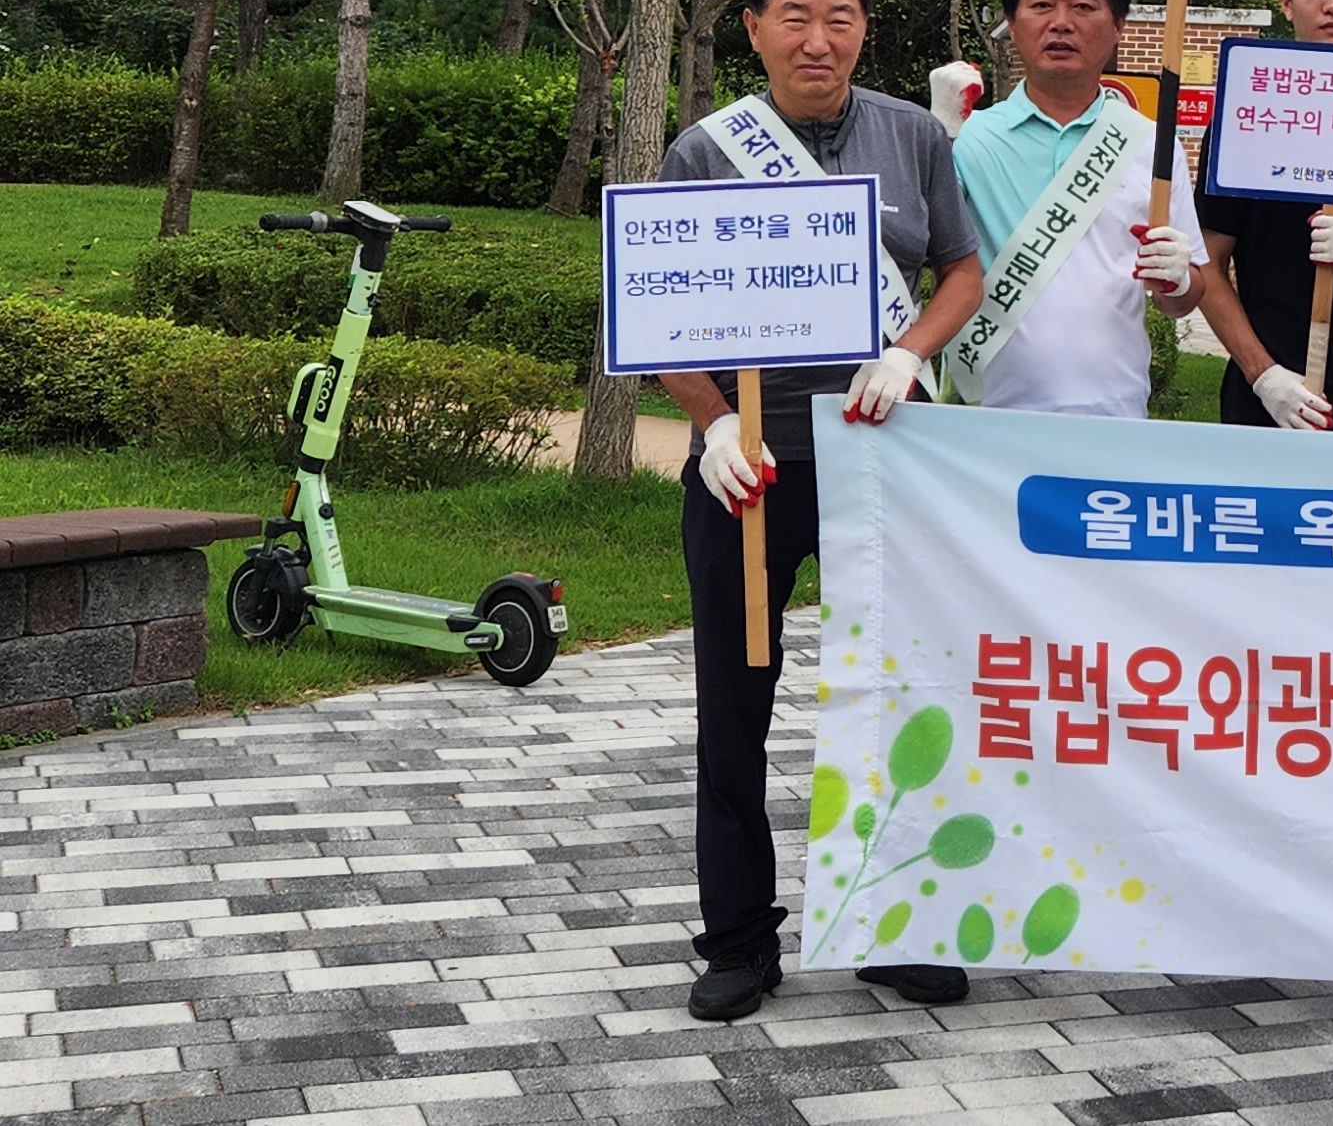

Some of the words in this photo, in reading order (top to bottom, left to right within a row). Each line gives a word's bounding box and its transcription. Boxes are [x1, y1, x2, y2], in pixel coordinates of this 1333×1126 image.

[1236, 106, 1322, 135] 연수구의
[1066, 124, 1128, 204] 건전한
[624, 219, 699, 245] 안전한
[714, 215, 790, 242] 통학을
[806, 211, 856, 238] 위해
[624, 270, 733, 296] 정당현수막
[745, 263, 859, 289] 자제합시다
[988, 203, 1077, 312] 광고문화
[688, 324, 751, 341] 인천광역시
[958, 314, 999, 374] 정착
[1080, 490, 1264, 554] 올바른
